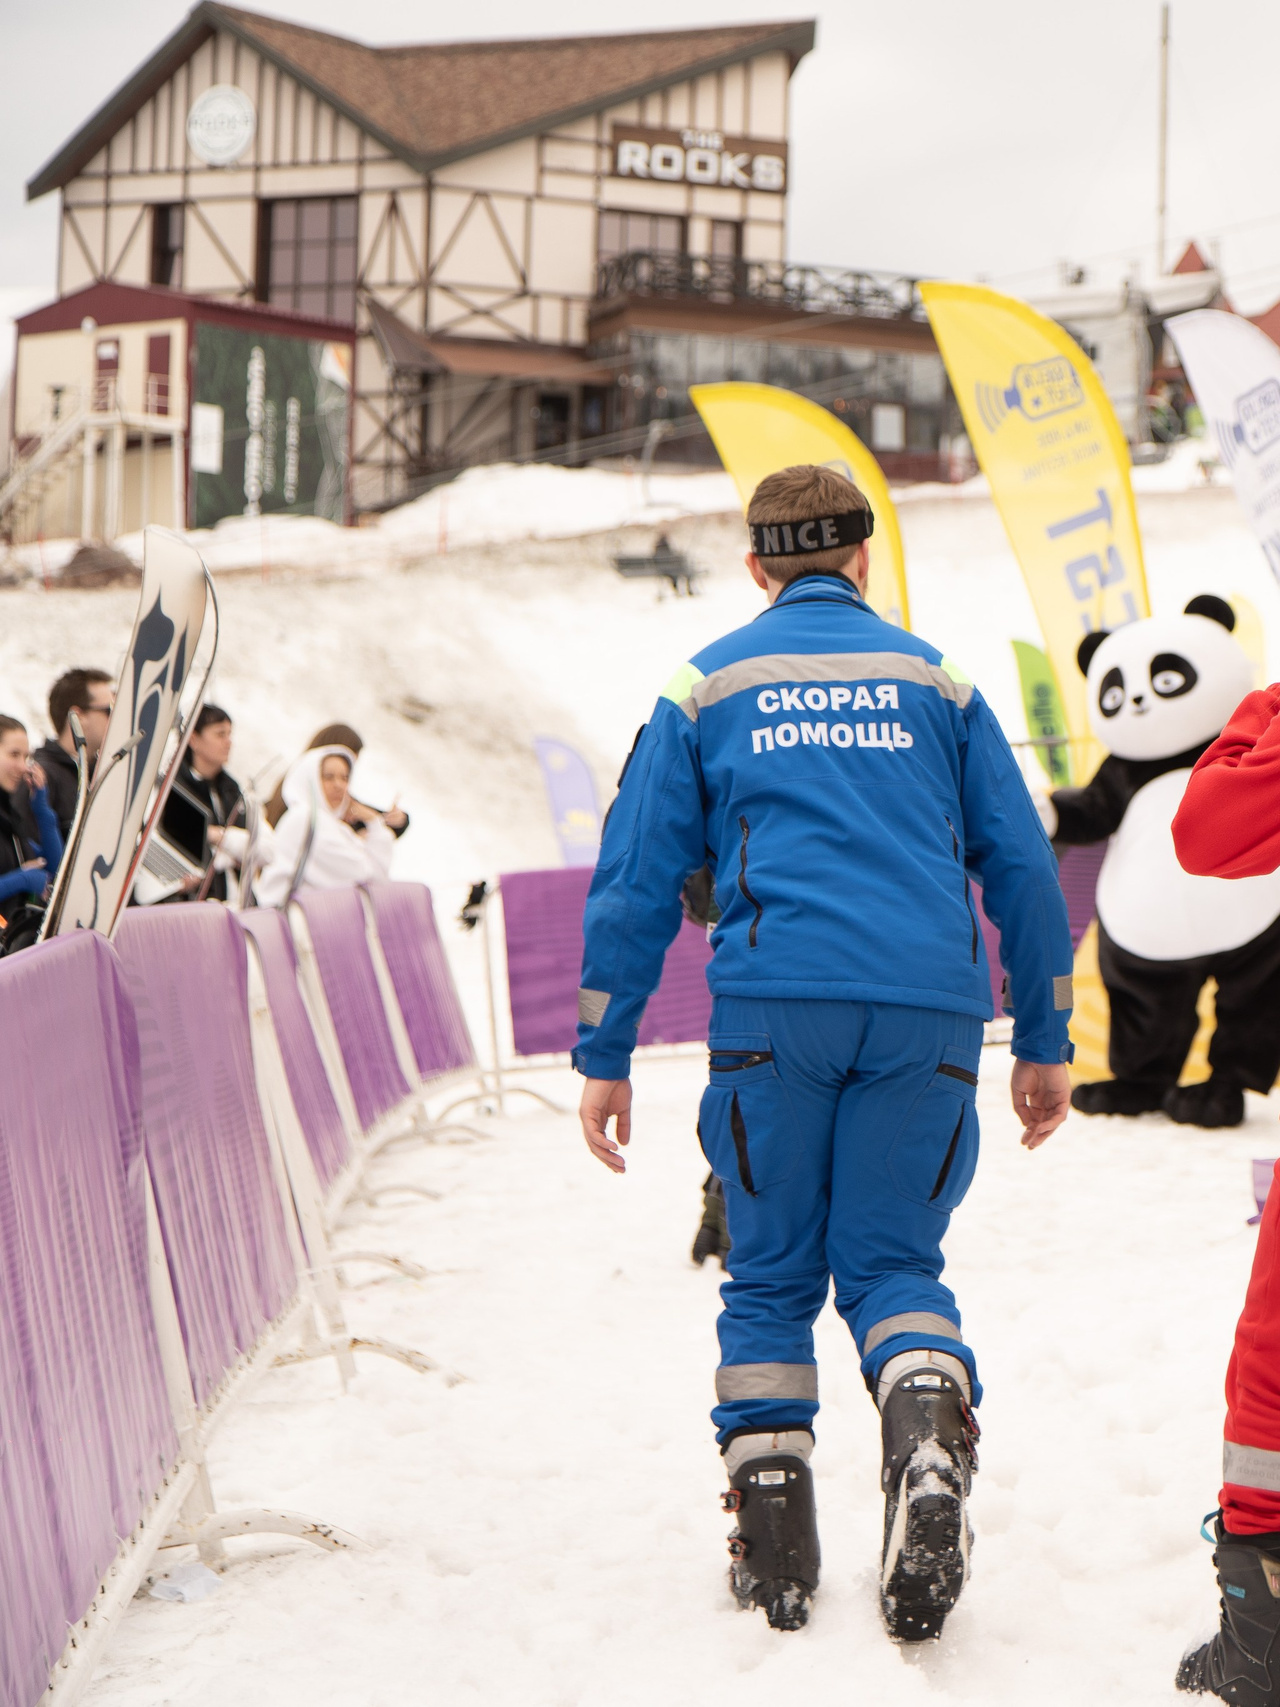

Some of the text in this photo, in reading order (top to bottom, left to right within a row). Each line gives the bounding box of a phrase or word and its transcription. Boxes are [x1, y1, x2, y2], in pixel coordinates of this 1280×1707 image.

[617, 139, 786, 191] ROOKS
[762, 518, 839, 554] NICE
[756, 684, 899, 714] СКОРАЯ
[751, 722, 913, 754] ПОМОЩЬ
